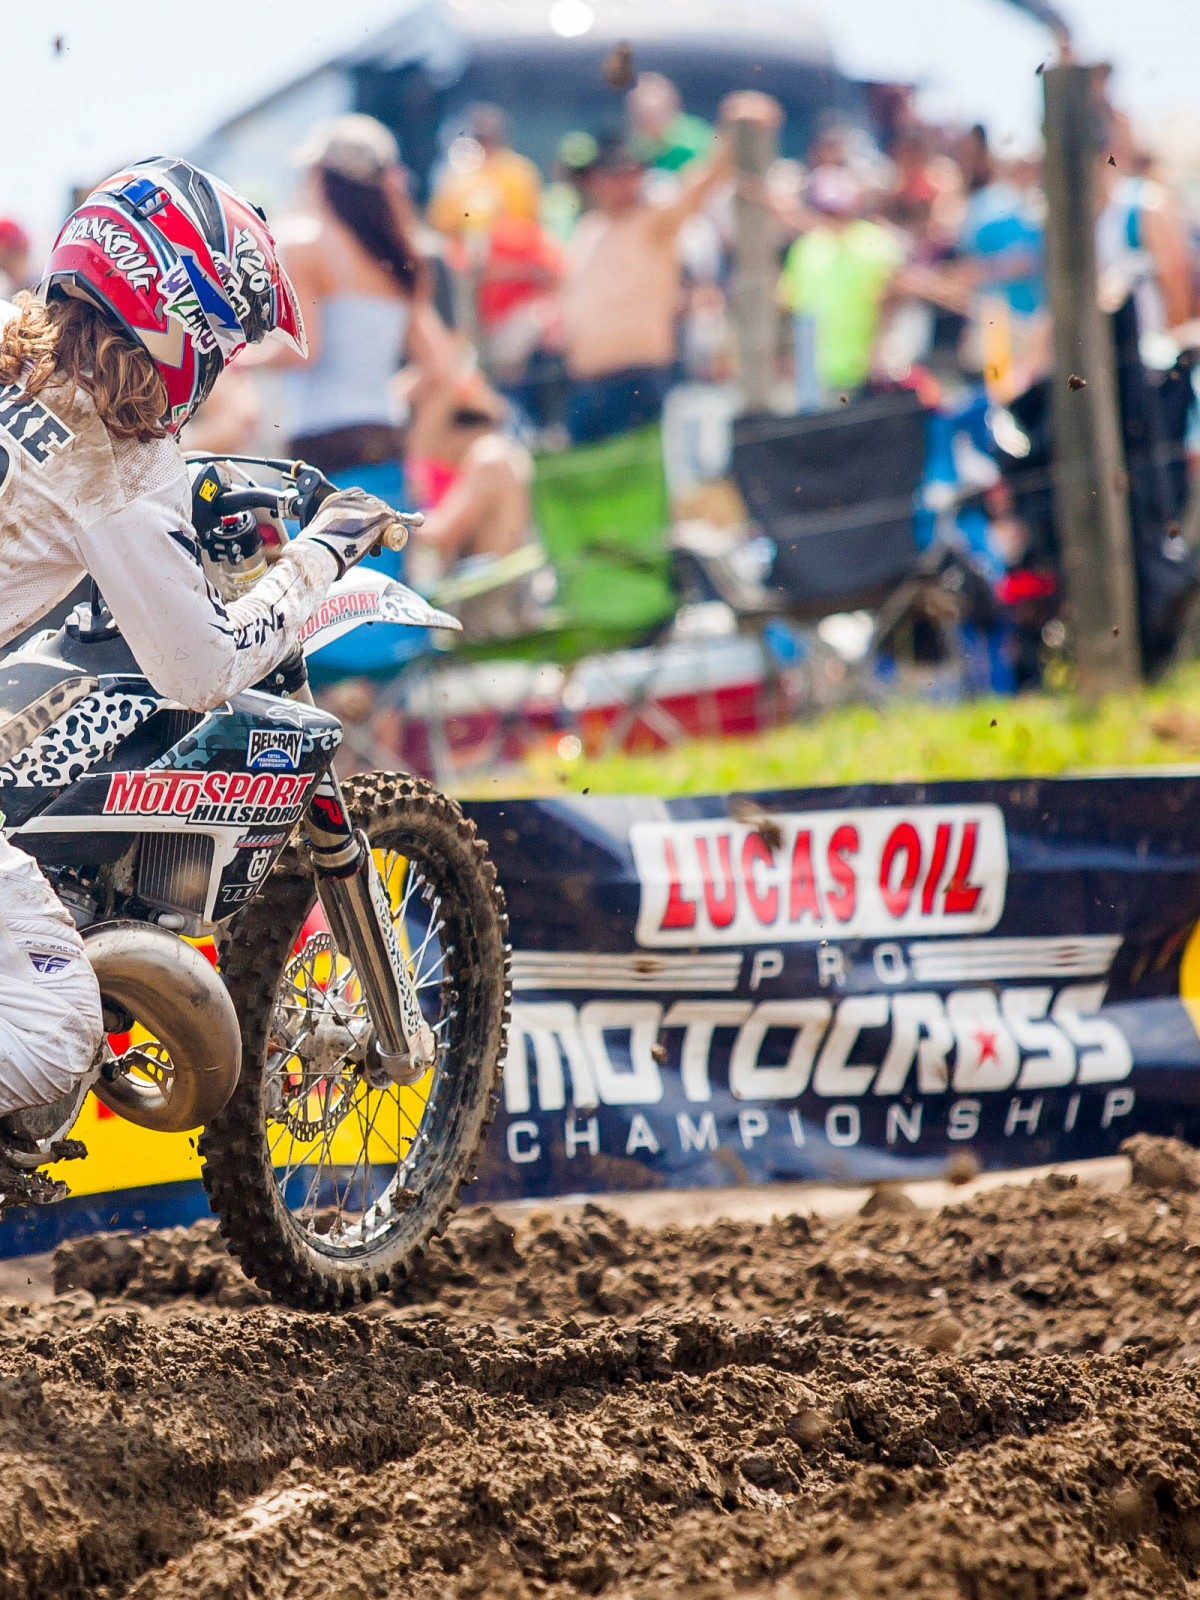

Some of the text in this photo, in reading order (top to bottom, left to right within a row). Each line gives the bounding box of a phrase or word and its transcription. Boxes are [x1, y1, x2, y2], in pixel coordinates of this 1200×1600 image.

[236, 227, 272, 293] 726
[191, 803, 303, 822] HILLSBORO
[659, 820, 983, 930] LUCAS OIL
[749, 942, 912, 988] PRO
[503, 981, 1134, 1114] MOTOCROSS
[506, 1087, 1135, 1165] CHAMPIONSHIP
